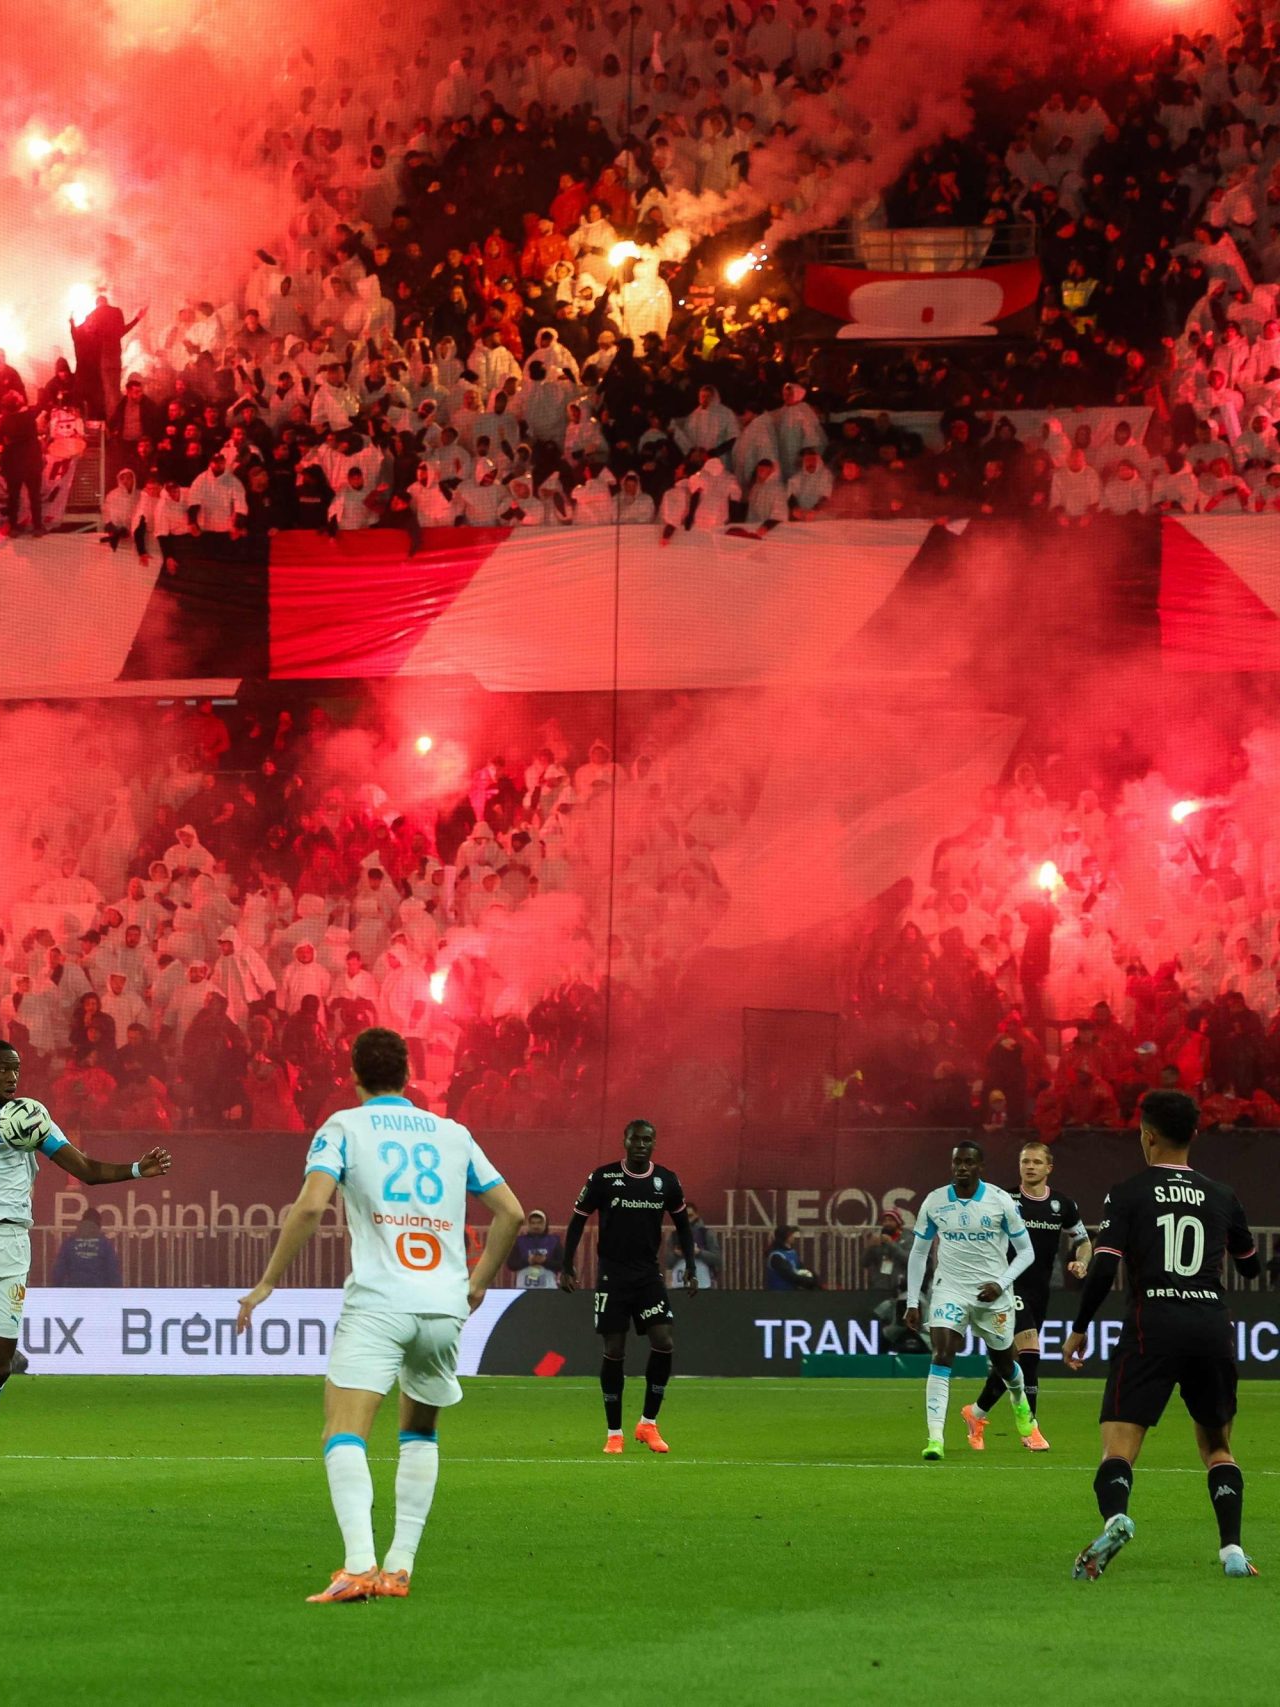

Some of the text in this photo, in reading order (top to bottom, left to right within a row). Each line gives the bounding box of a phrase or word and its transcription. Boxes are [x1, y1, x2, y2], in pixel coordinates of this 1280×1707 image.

[370, 1115, 437, 1132] PAVARD
[377, 1140, 443, 1205] 28
[1154, 1186, 1205, 1206] S.DIOP
[968, 1232, 994, 1241] CGM
[1157, 1213, 1204, 1277] 10
[594, 1293, 608, 1313] 37
[945, 1303, 964, 1325] 22
